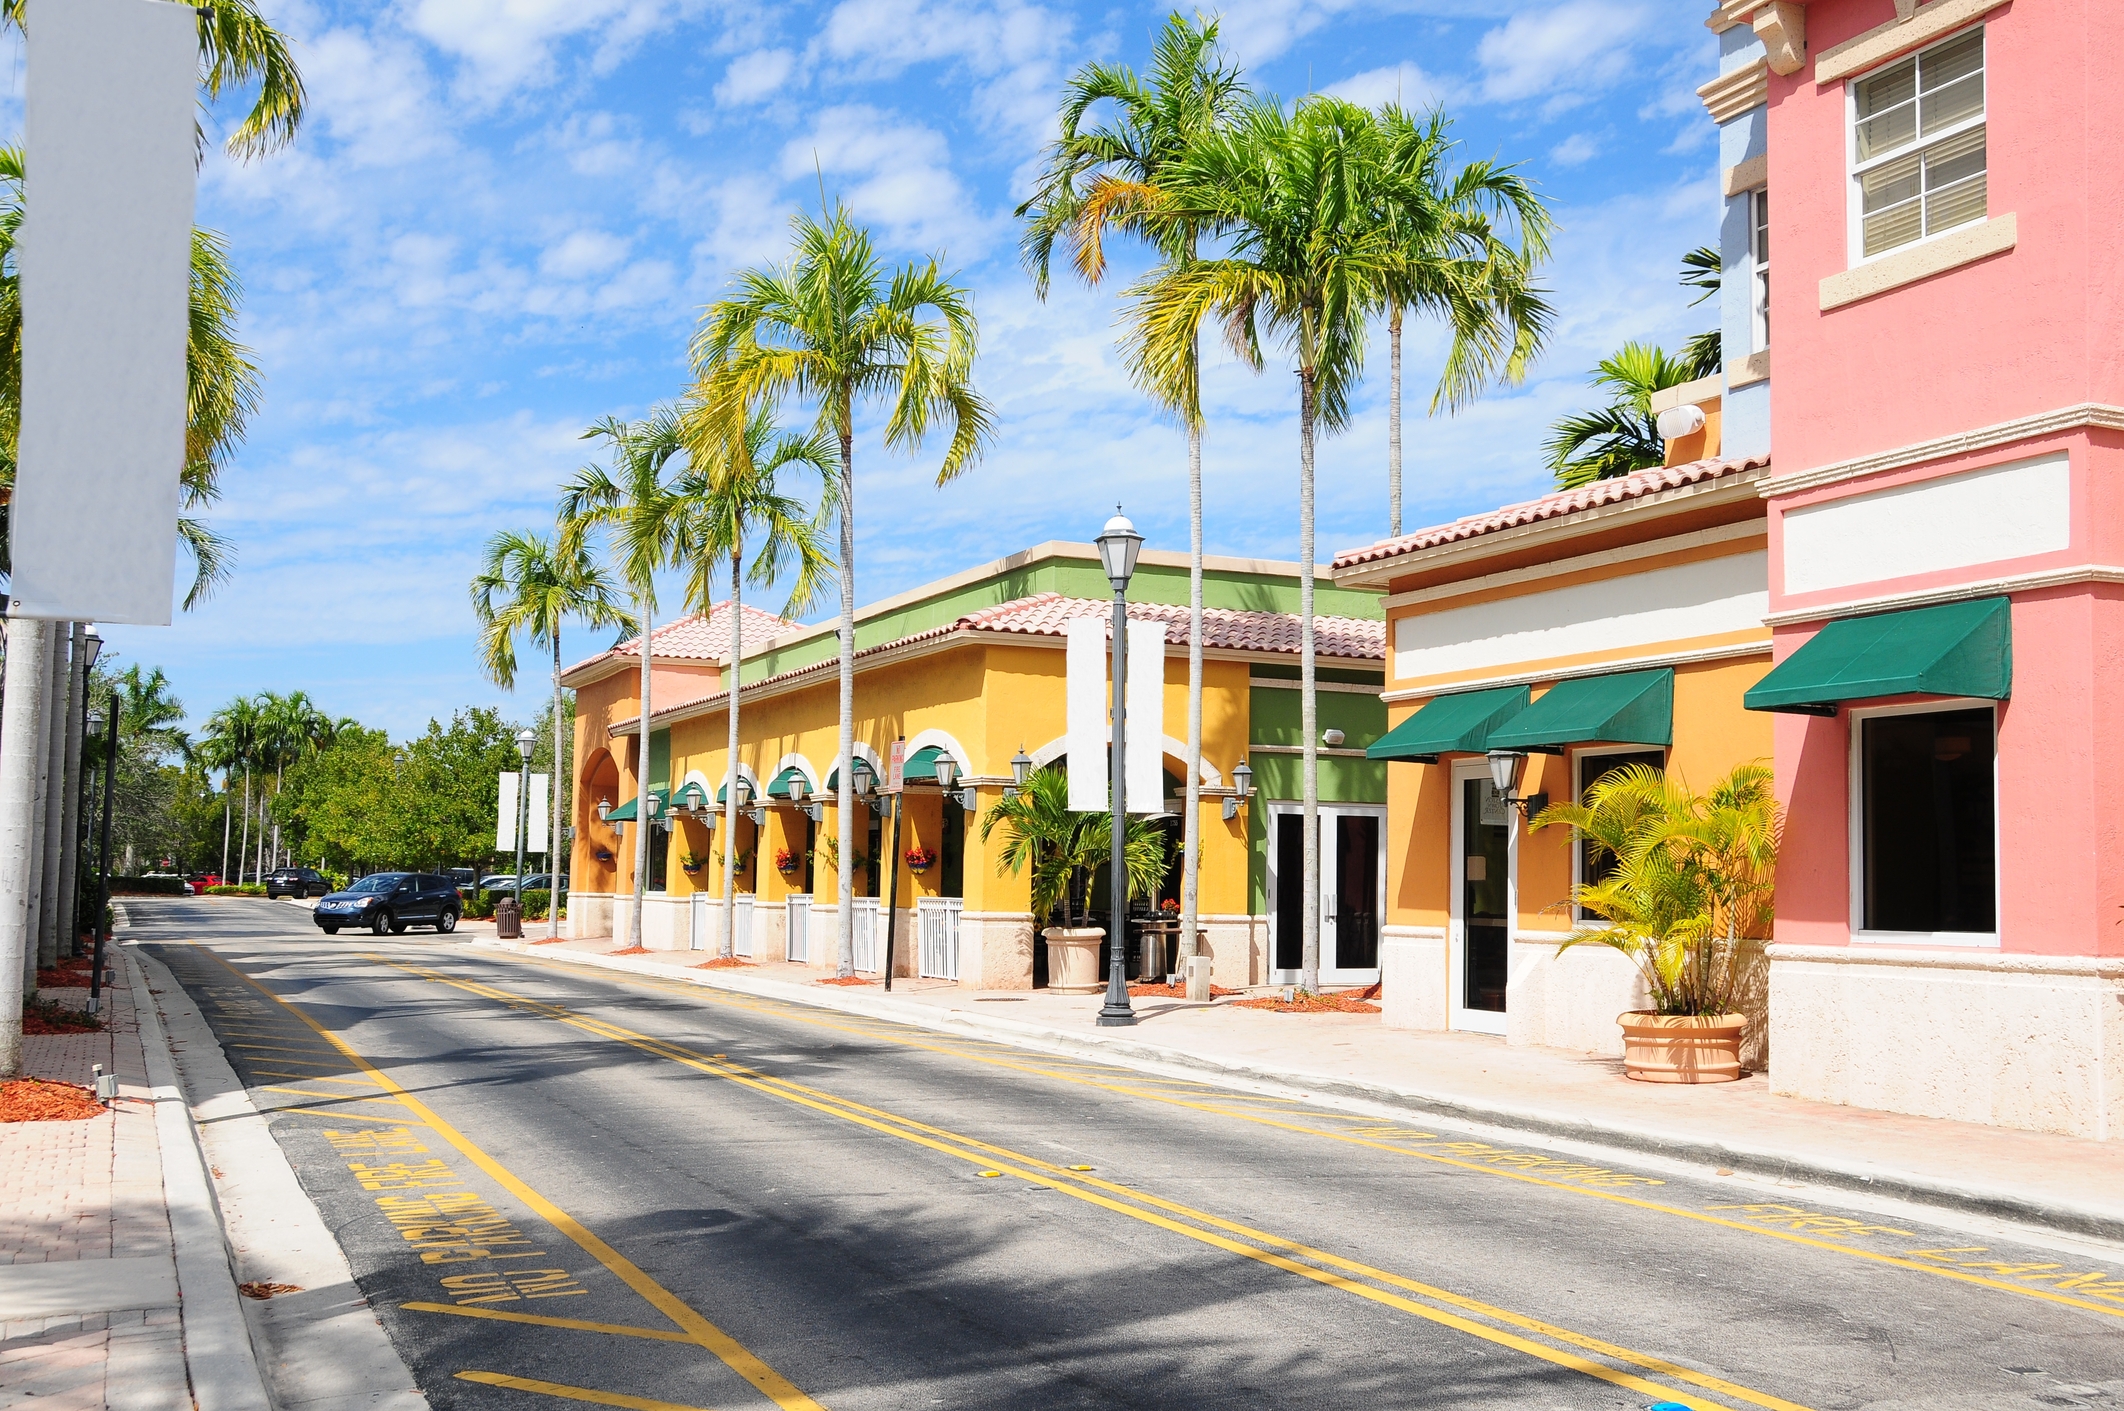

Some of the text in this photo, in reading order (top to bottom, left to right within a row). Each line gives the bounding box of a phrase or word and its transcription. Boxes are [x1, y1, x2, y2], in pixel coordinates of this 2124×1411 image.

[893, 772, 901, 780] LANE
[323, 1128, 589, 1305] NO PARKING FIRE LANE
[1335, 1127, 1438, 1140] NO
[1411, 1142, 1667, 1187] PARKING
[1704, 1204, 1916, 1239] FIRE
